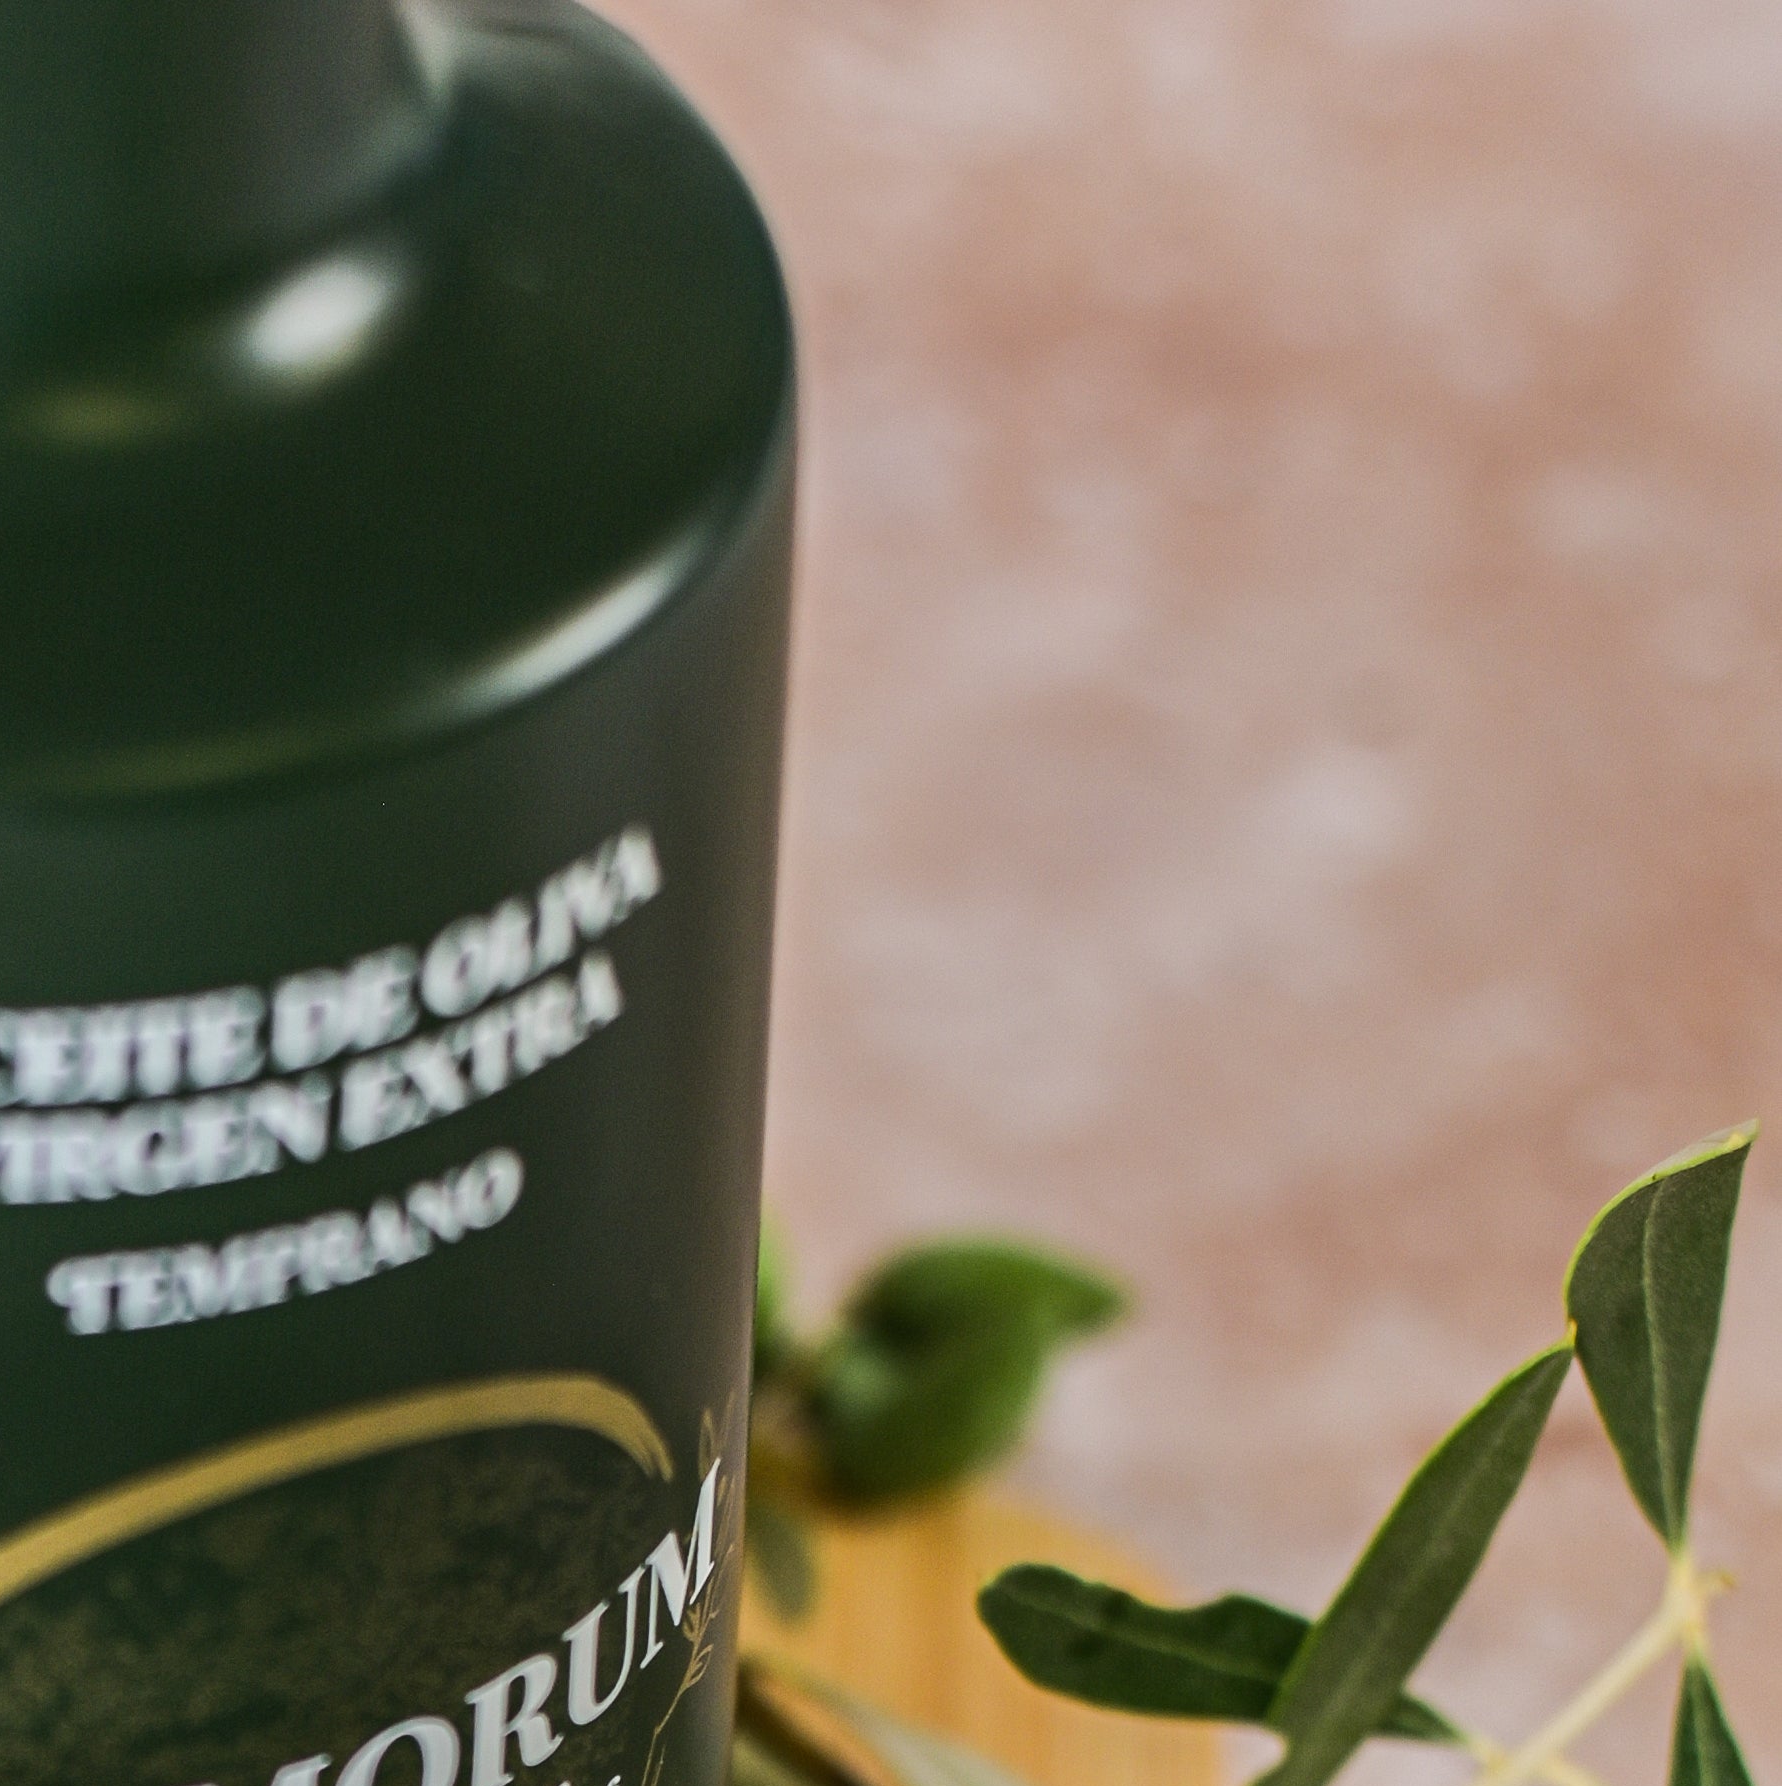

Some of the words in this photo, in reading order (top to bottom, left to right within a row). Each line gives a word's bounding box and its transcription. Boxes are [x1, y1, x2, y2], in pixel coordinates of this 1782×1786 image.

[270, 944, 418, 1072] DE
[420, 824, 661, 1018] OLIVA
[338, 950, 622, 1151] EXTRA
[45, 1147, 524, 1336] TEMPRANO
